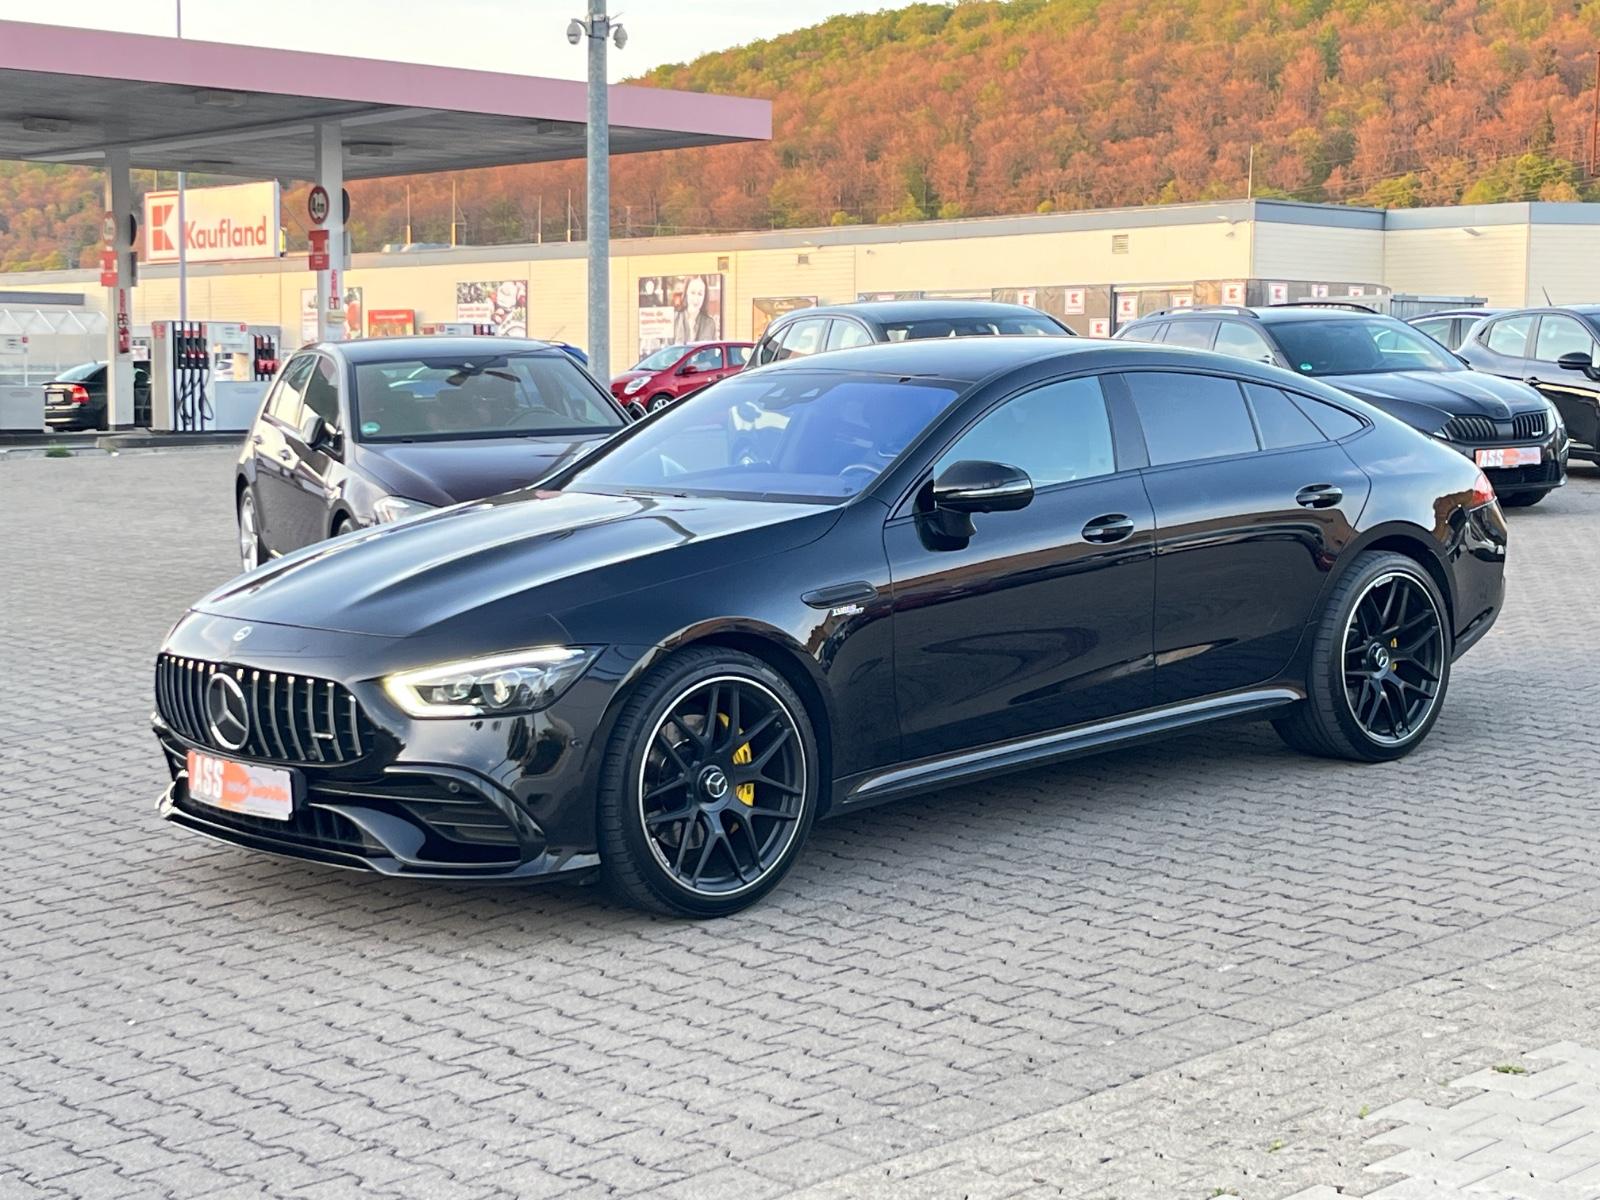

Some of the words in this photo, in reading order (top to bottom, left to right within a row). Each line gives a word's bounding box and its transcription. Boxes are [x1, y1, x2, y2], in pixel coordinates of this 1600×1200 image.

[152, 204, 175, 251] K
[184, 215, 267, 249] Kaufland
[1481, 449, 1504, 468] ASS
[193, 754, 225, 799] ASS
